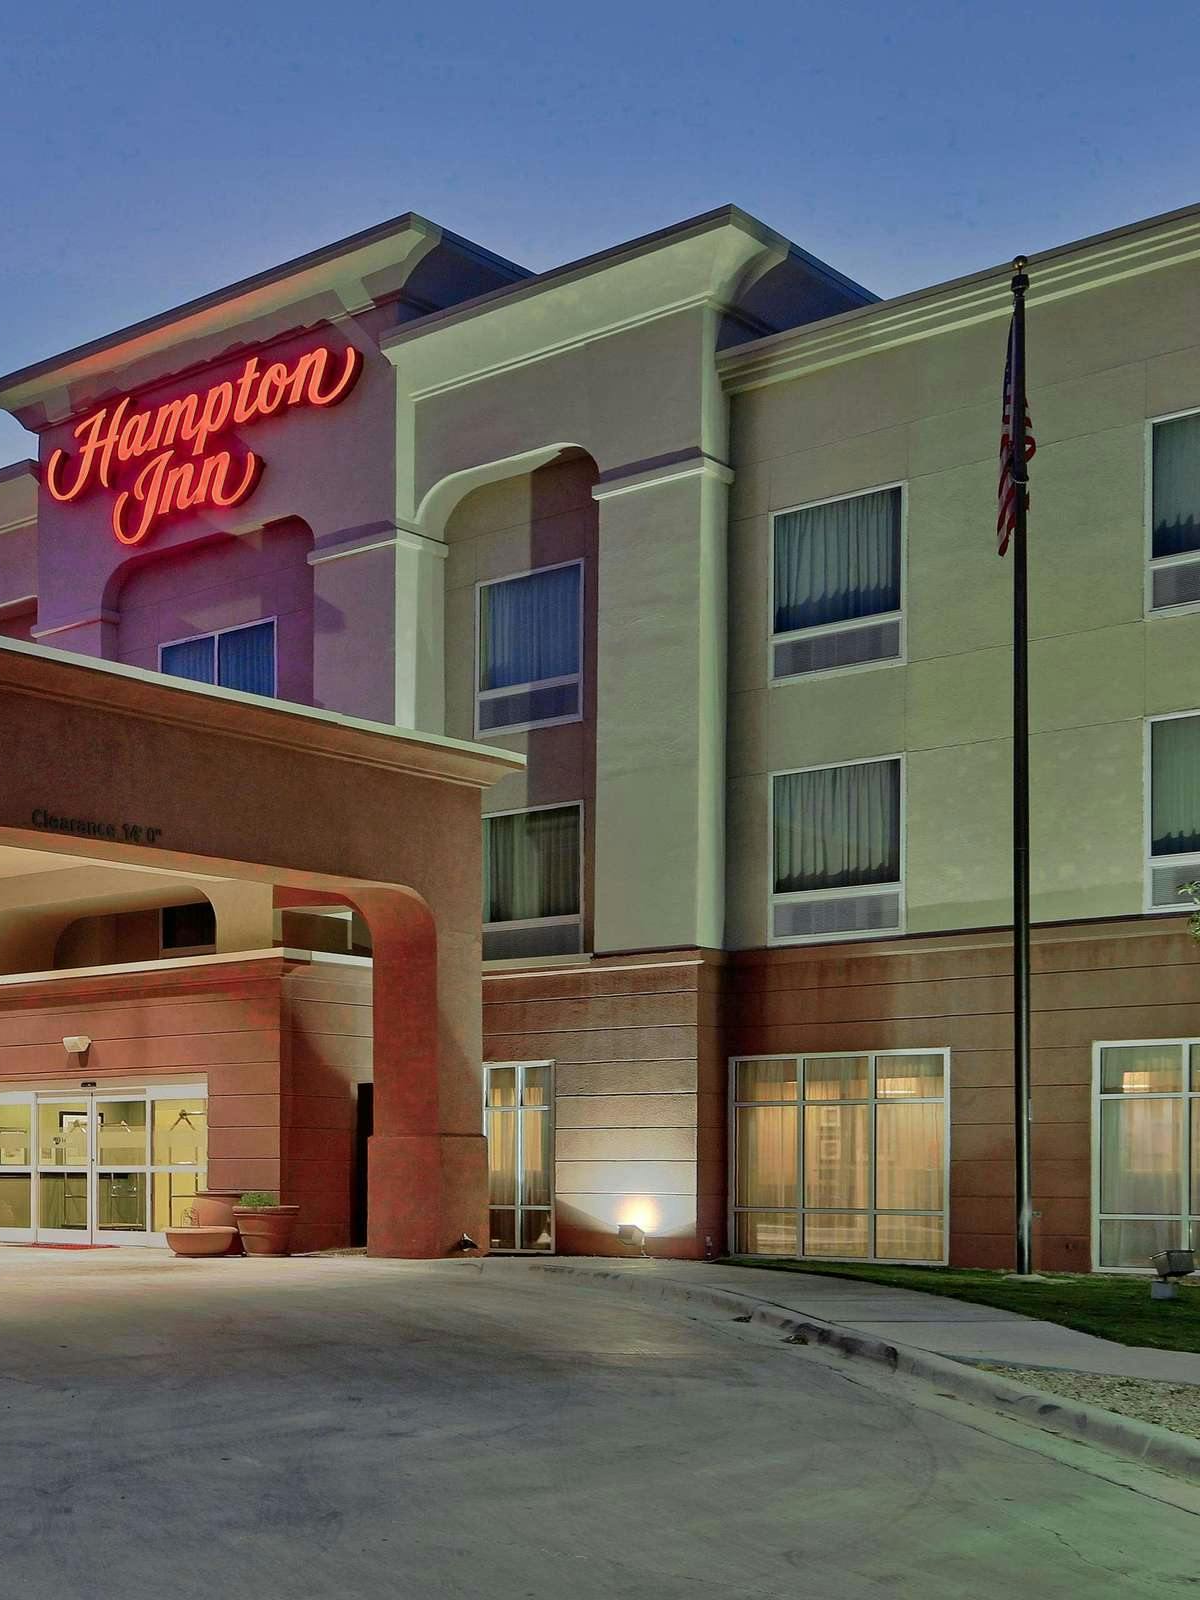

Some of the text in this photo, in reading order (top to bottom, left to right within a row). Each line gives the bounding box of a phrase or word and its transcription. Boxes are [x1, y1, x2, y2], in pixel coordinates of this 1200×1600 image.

[47, 346, 360, 501] Hampton
[112, 449, 261, 545] Inn
[31, 808, 116, 838] Clearance
